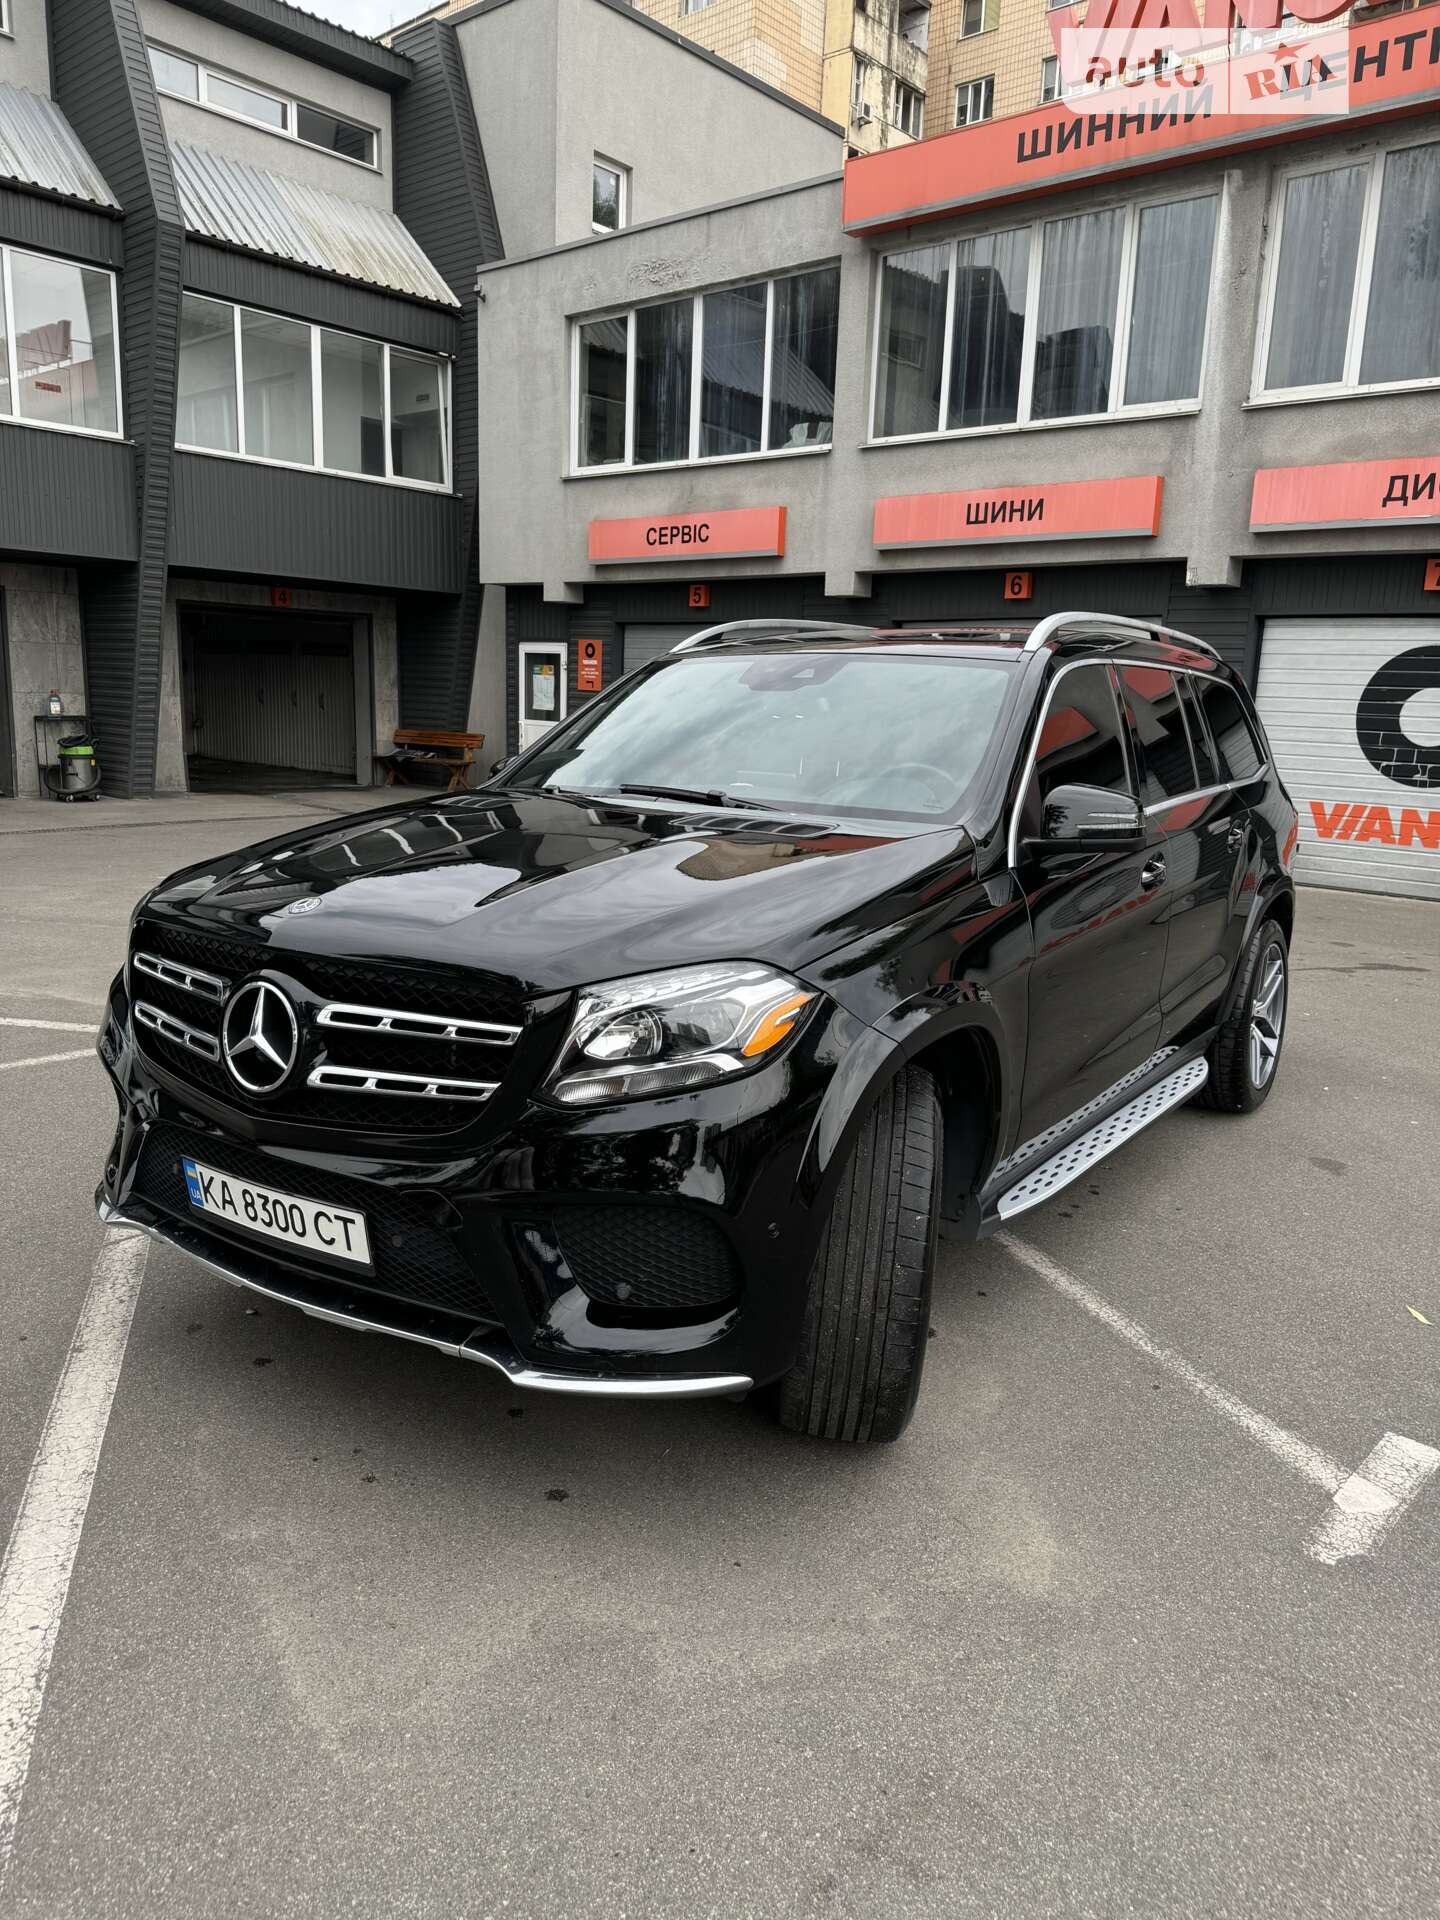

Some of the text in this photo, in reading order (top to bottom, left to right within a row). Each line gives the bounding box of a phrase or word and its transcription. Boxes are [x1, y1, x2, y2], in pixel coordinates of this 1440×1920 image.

[1381, 472, 1440, 508] ДИ
[966, 498, 1045, 525] ШИНИ
[646, 523, 710, 546] СЕРВІС
[693, 586, 702, 604] 5
[1010, 575, 1022, 596] 6
[191, 1188, 201, 1200] UA
[199, 1171, 356, 1252] KA 8300 CT
